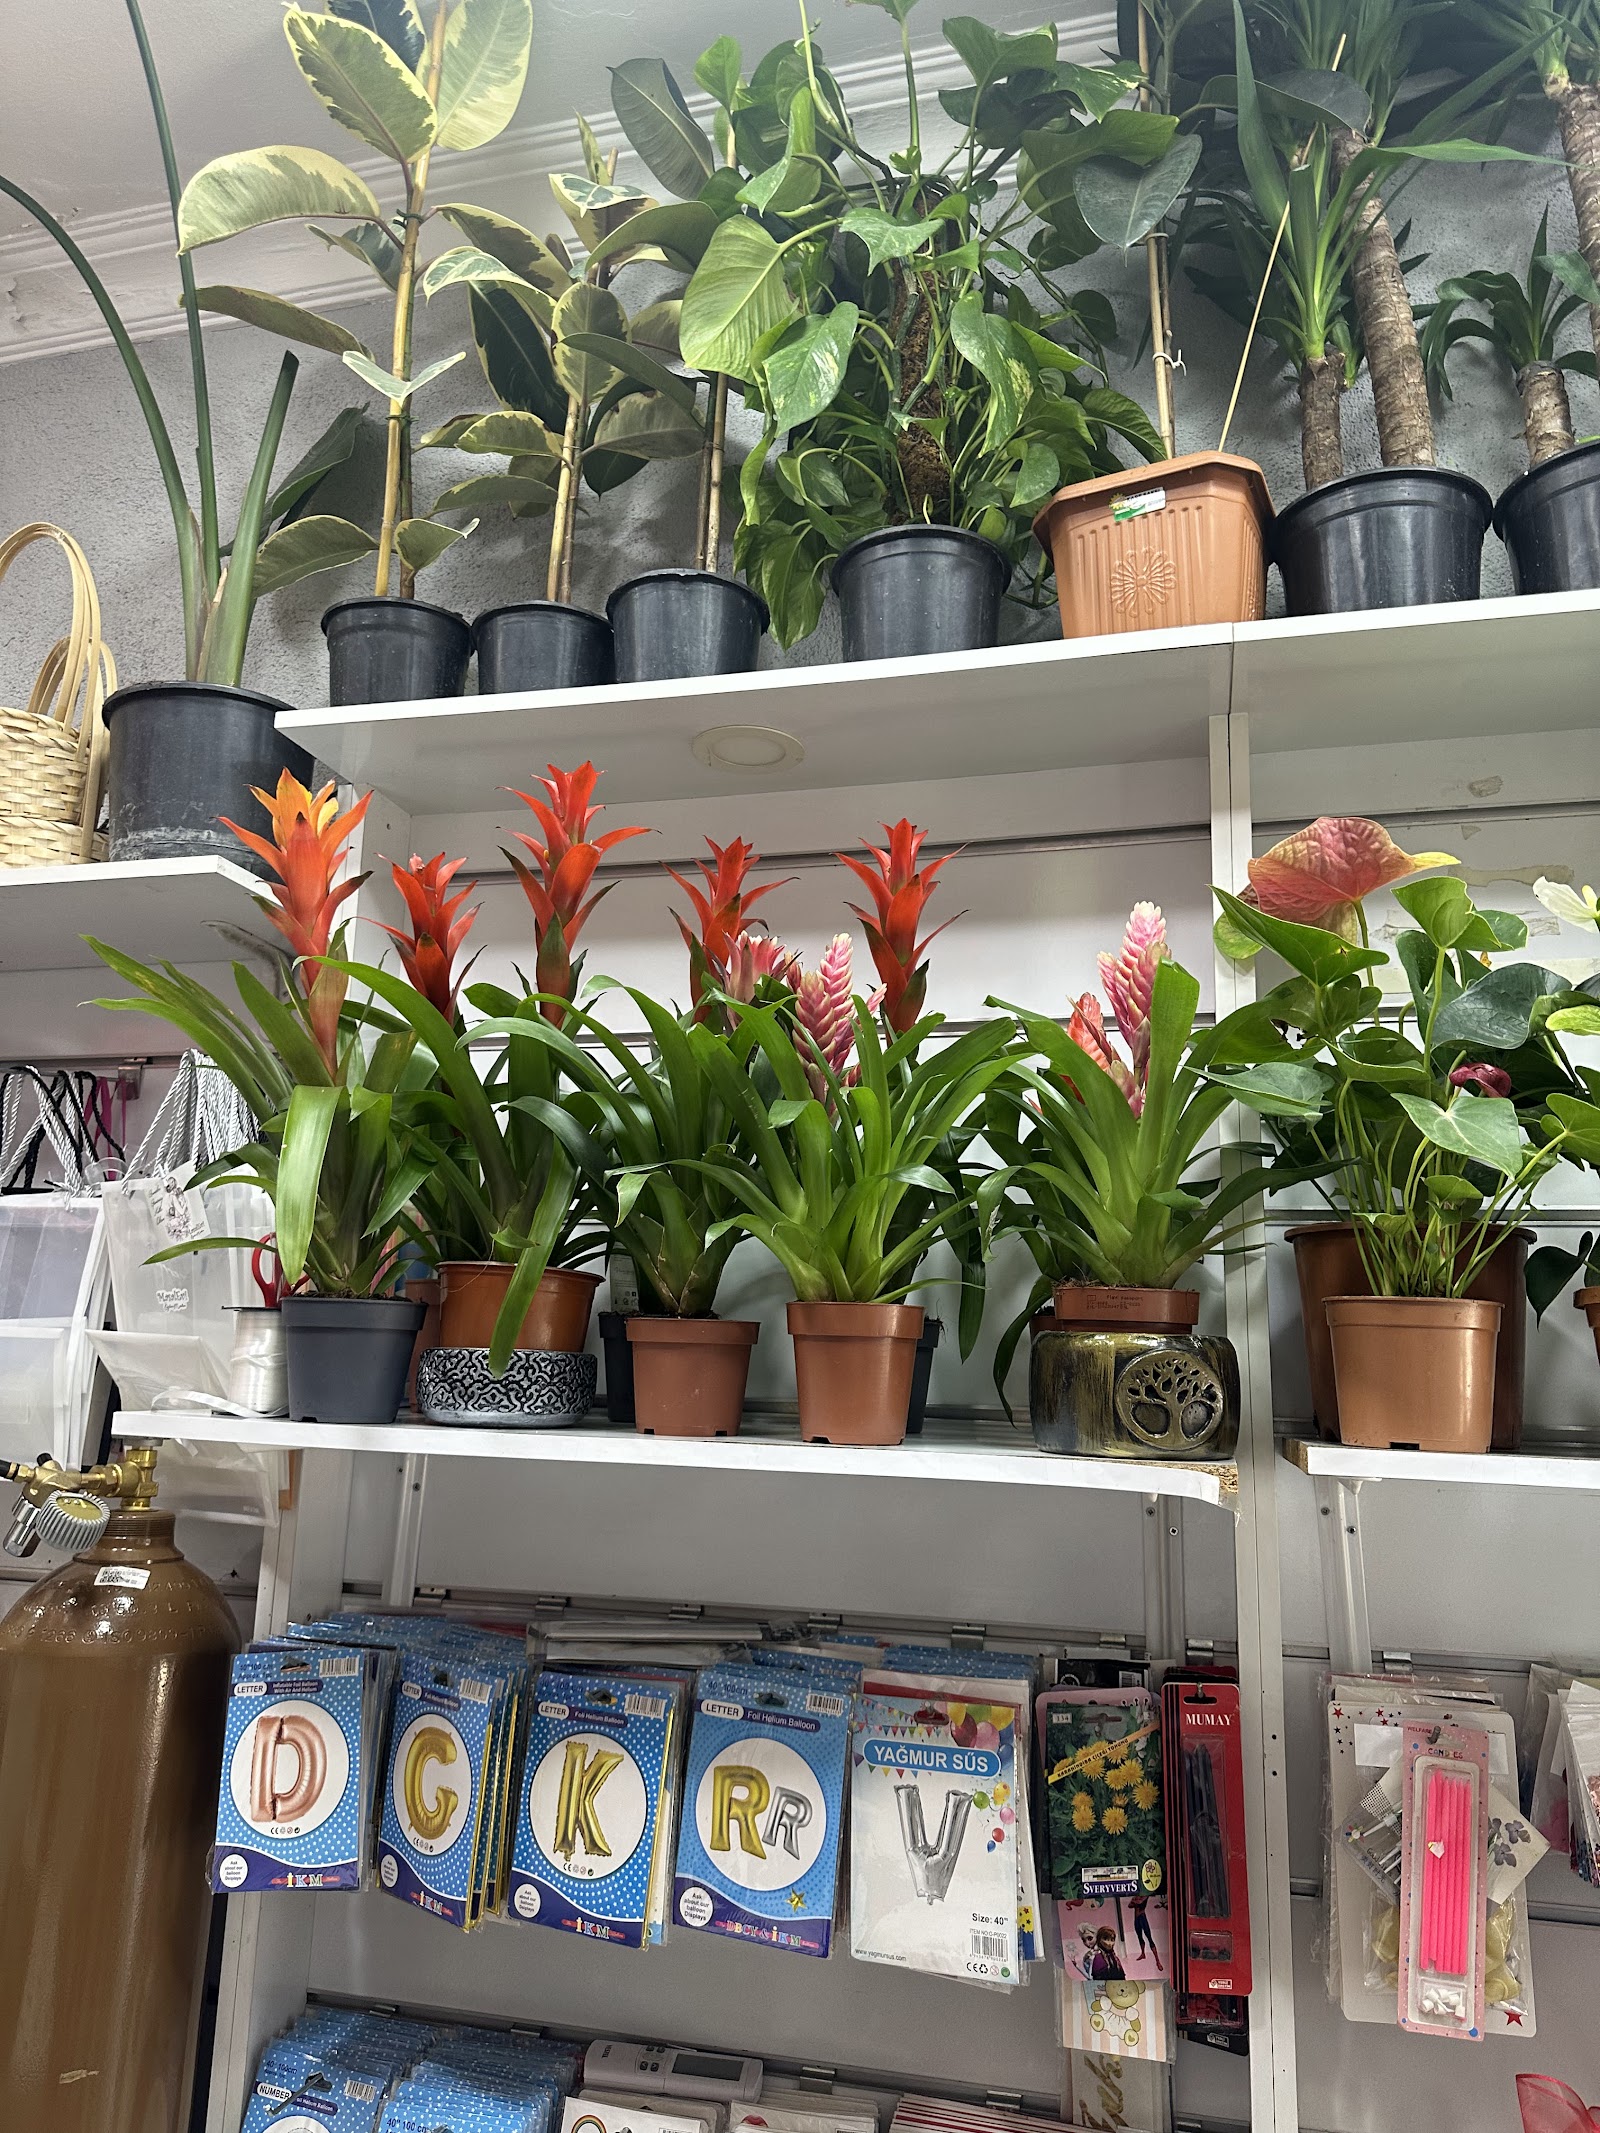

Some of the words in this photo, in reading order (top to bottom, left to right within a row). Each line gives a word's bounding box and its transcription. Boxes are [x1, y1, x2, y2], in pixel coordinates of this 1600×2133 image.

[236, 1684, 264, 1694] LETTER
[403, 1683, 421, 1696] LETTER
[540, 1705, 566, 1716] LETTER
[705, 1703, 740, 1717] LETTER
[747, 1711, 760, 1720] Foil
[762, 1713, 787, 1725] Helium
[788, 1718, 816, 1730] Balloon
[1185, 1713, 1233, 1726] MUMAY
[1407, 1726, 1432, 1734] WELFARE
[873, 1744, 948, 1769] YAĞMUR
[404, 1726, 459, 1841] G
[553, 1740, 625, 1858] K
[709, 1765, 771, 1860] R
[893, 1783, 974, 1904] V
[684, 1898, 699, 1906] about
[684, 1911, 707, 1921] Displays
[686, 1905, 706, 1914] balloon
[972, 1912, 993, 1924] Size:
[259, 2085, 290, 2100] NUMBER
[402, 2120, 416, 2132] 100
